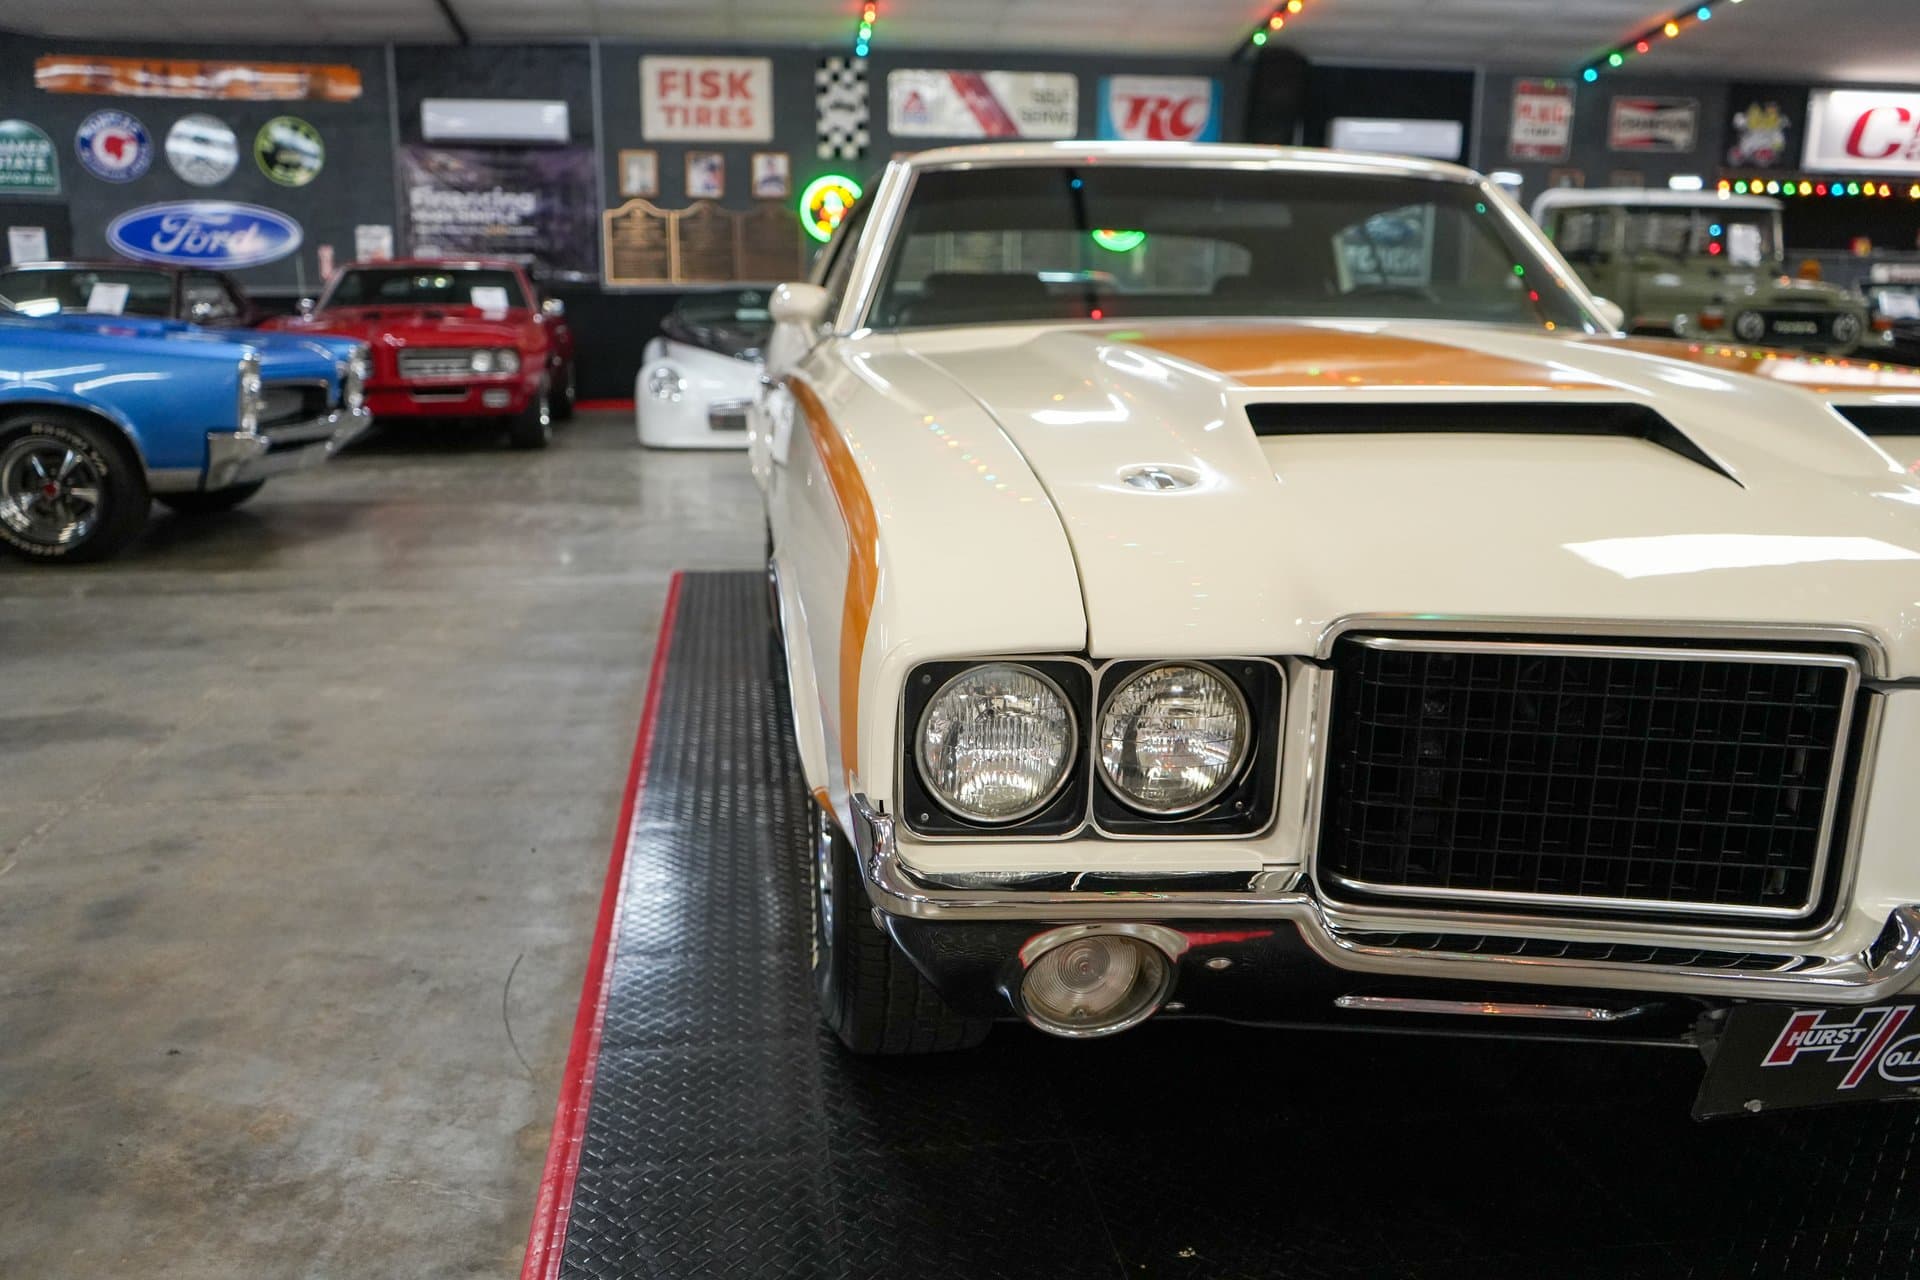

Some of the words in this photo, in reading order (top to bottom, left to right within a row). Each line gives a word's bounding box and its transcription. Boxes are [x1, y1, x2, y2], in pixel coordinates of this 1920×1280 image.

[657, 69, 754, 100] FISK
[661, 106, 754, 128] TIRES
[151, 213, 264, 254] Ford
[1786, 1027, 1868, 1047] HURST
